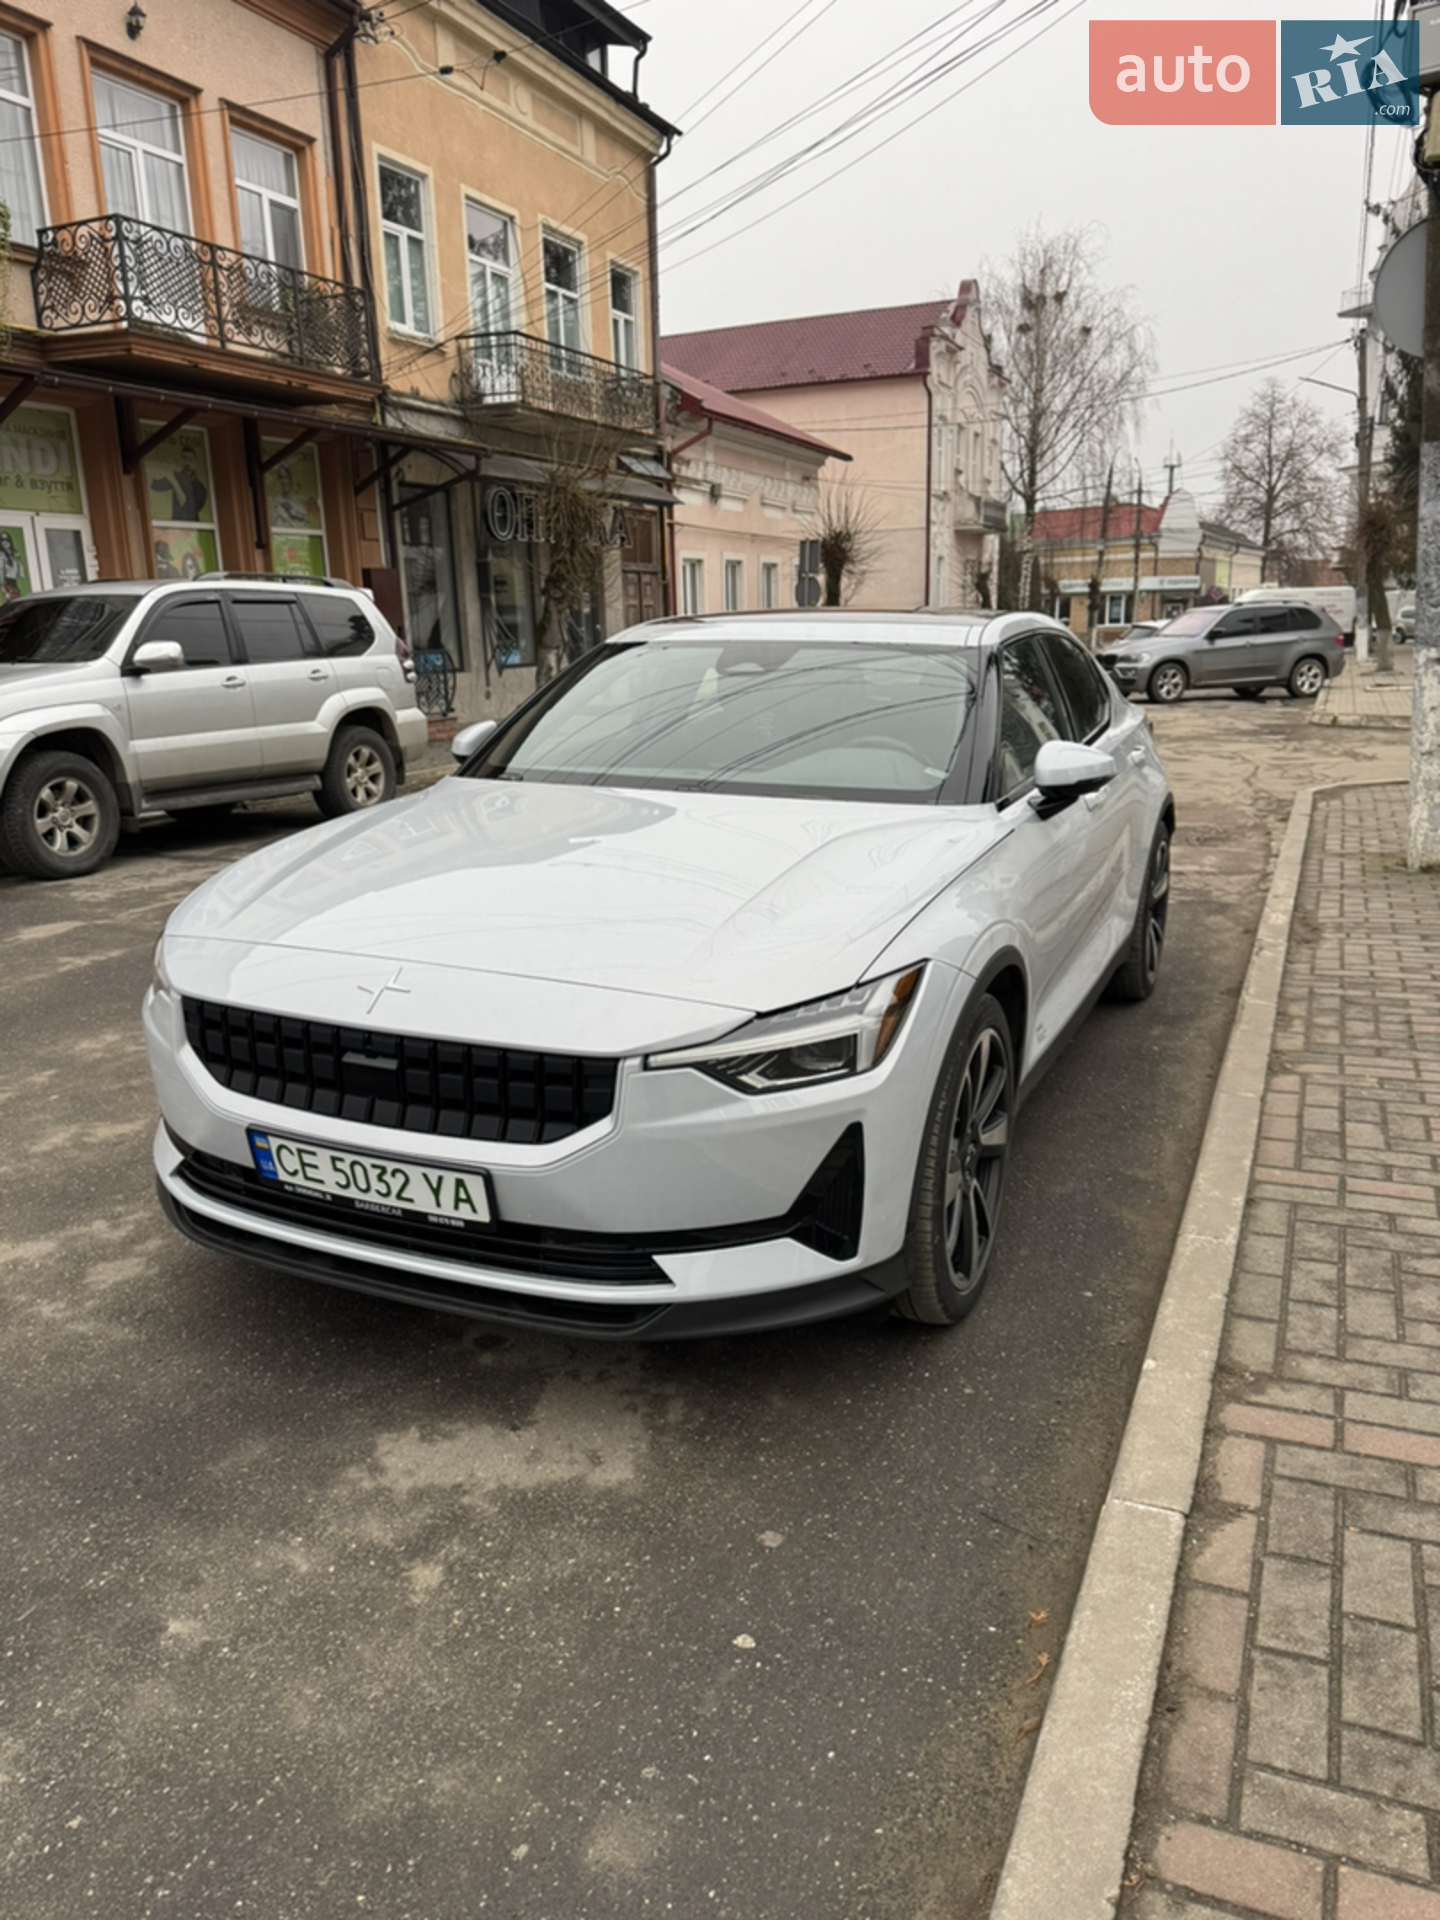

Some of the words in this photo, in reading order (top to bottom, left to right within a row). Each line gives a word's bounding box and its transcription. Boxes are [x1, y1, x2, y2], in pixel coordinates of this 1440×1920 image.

[0, 433, 72, 477] NDI
[275, 1143, 325, 1185] CE
[329, 1155, 415, 1203] 5032
[421, 1172, 478, 1214] YA
